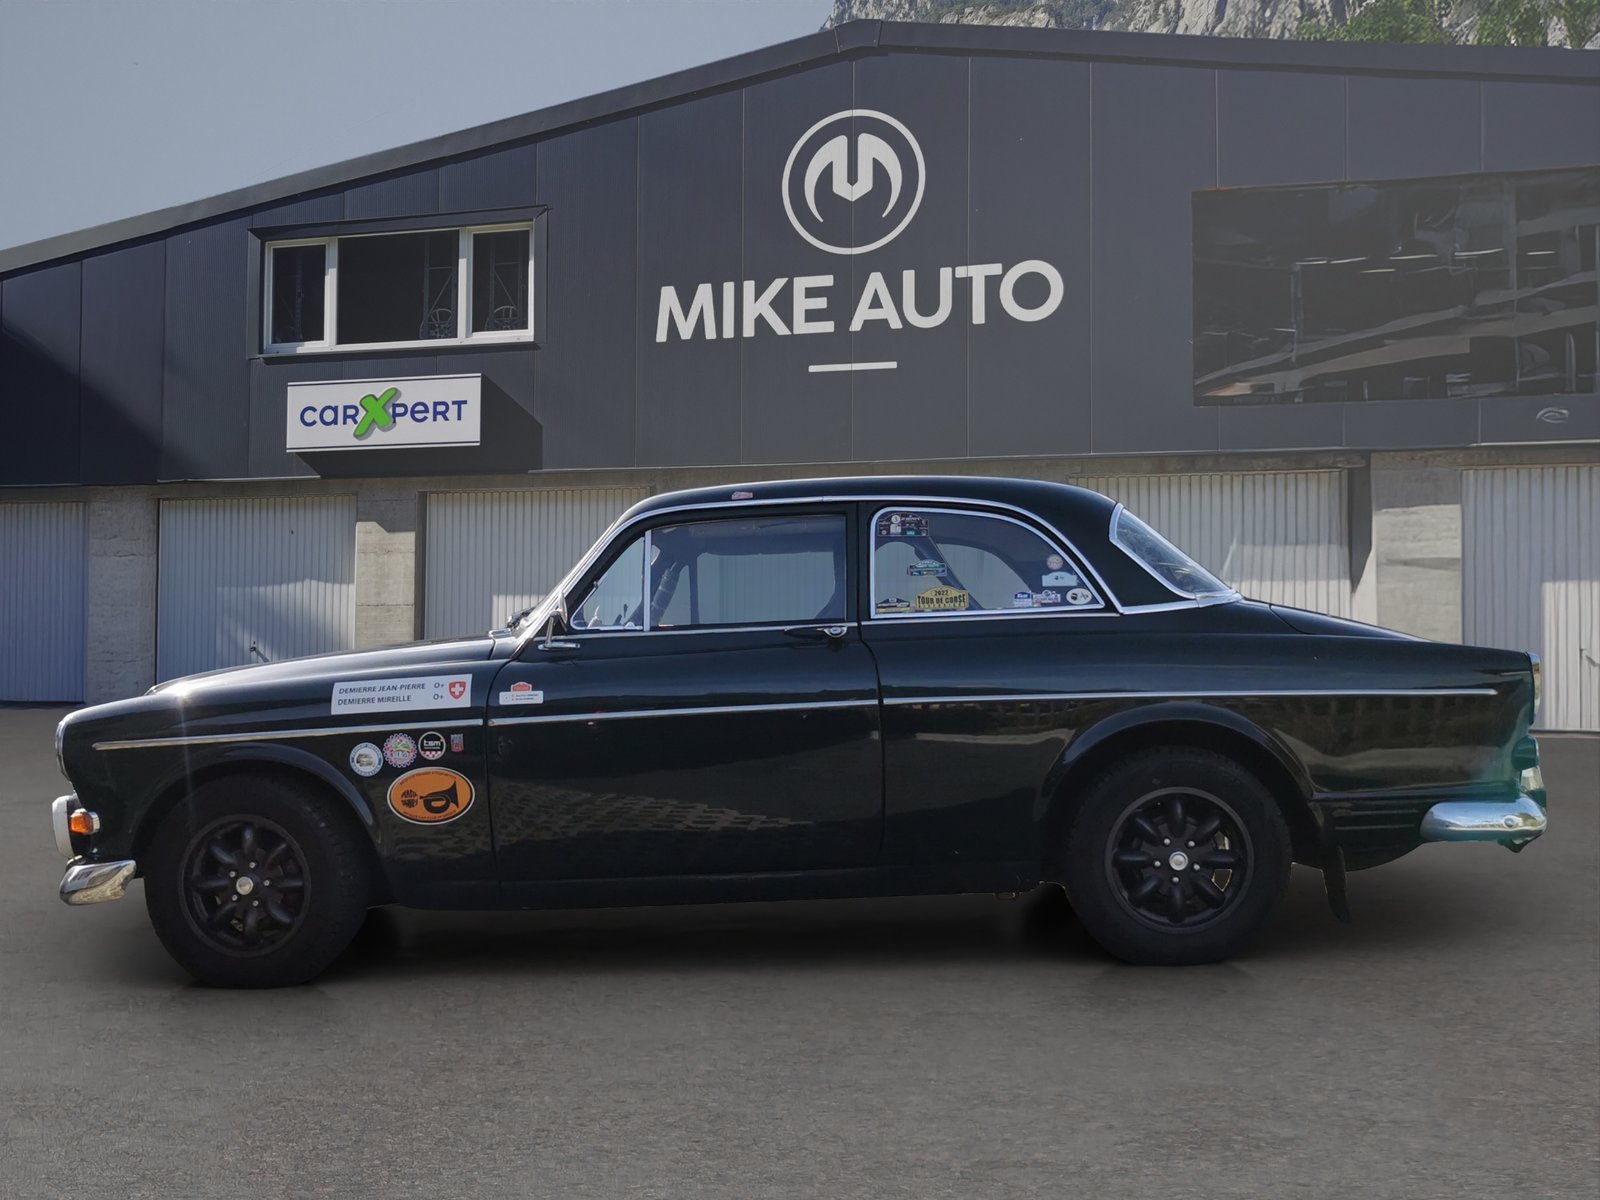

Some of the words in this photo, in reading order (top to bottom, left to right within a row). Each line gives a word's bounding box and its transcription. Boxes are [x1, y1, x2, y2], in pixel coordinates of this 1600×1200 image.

[656, 274, 835, 342] MIKE
[849, 259, 1064, 331] AUTO
[917, 595, 934, 605] TOUR
[936, 596, 943, 604] DE
[944, 593, 966, 604] CORSE
[338, 686, 377, 695] DEMIERRE
[377, 683, 426, 692] JEAN-PIERRE
[337, 696, 375, 706] DEMIERRE
[377, 695, 411, 704] MIREILLE
